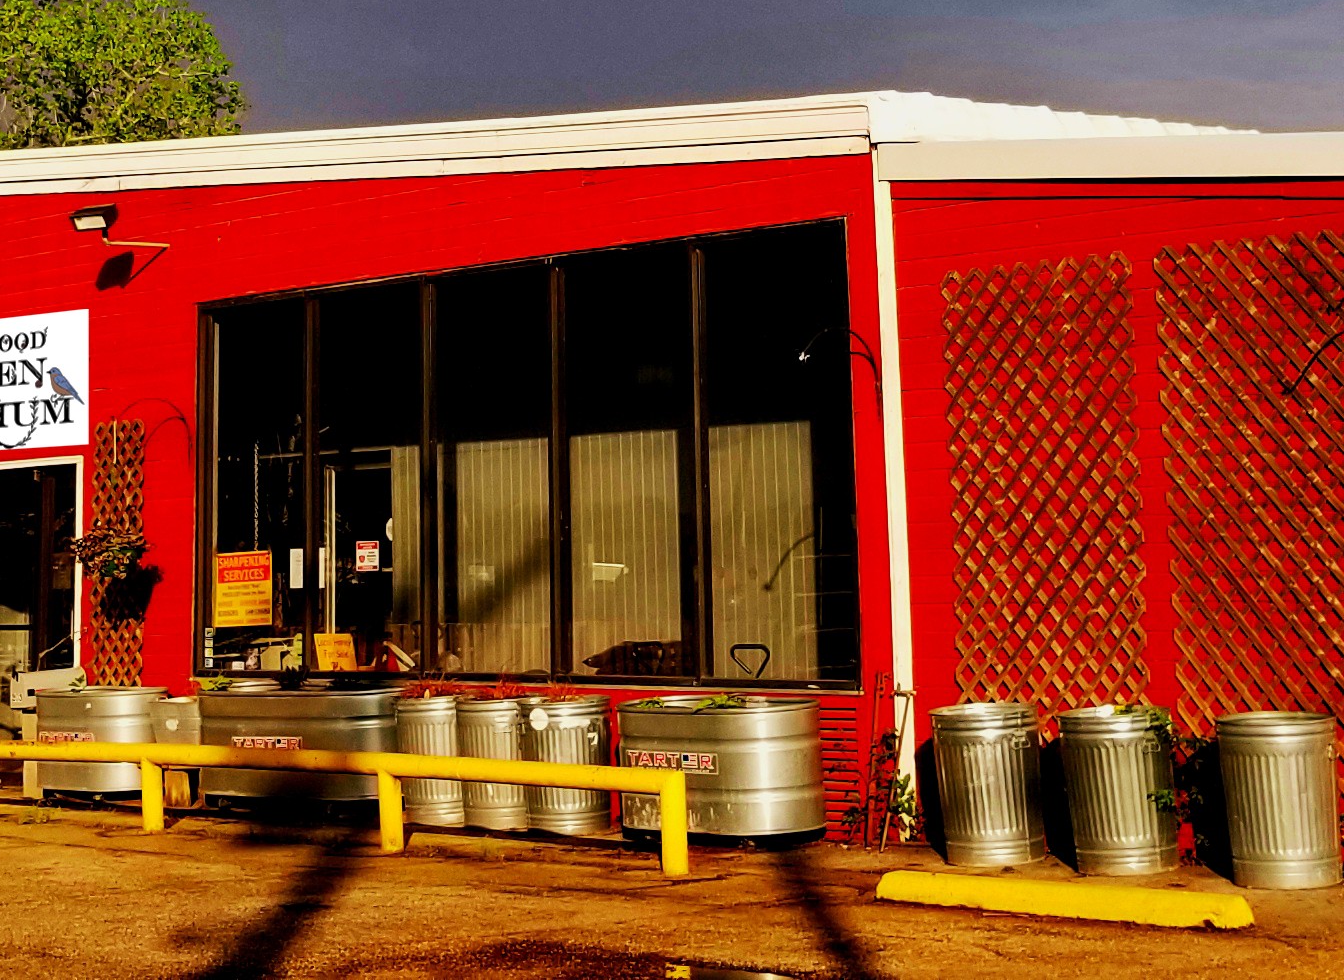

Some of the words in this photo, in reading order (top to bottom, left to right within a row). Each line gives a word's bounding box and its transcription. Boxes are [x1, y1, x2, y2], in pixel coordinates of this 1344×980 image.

[218, 555, 270, 569] SHARPENING
[223, 568, 265, 581] SERVICES
[233, 737, 300, 750] TARTER
[627, 750, 715, 770] TARTER
